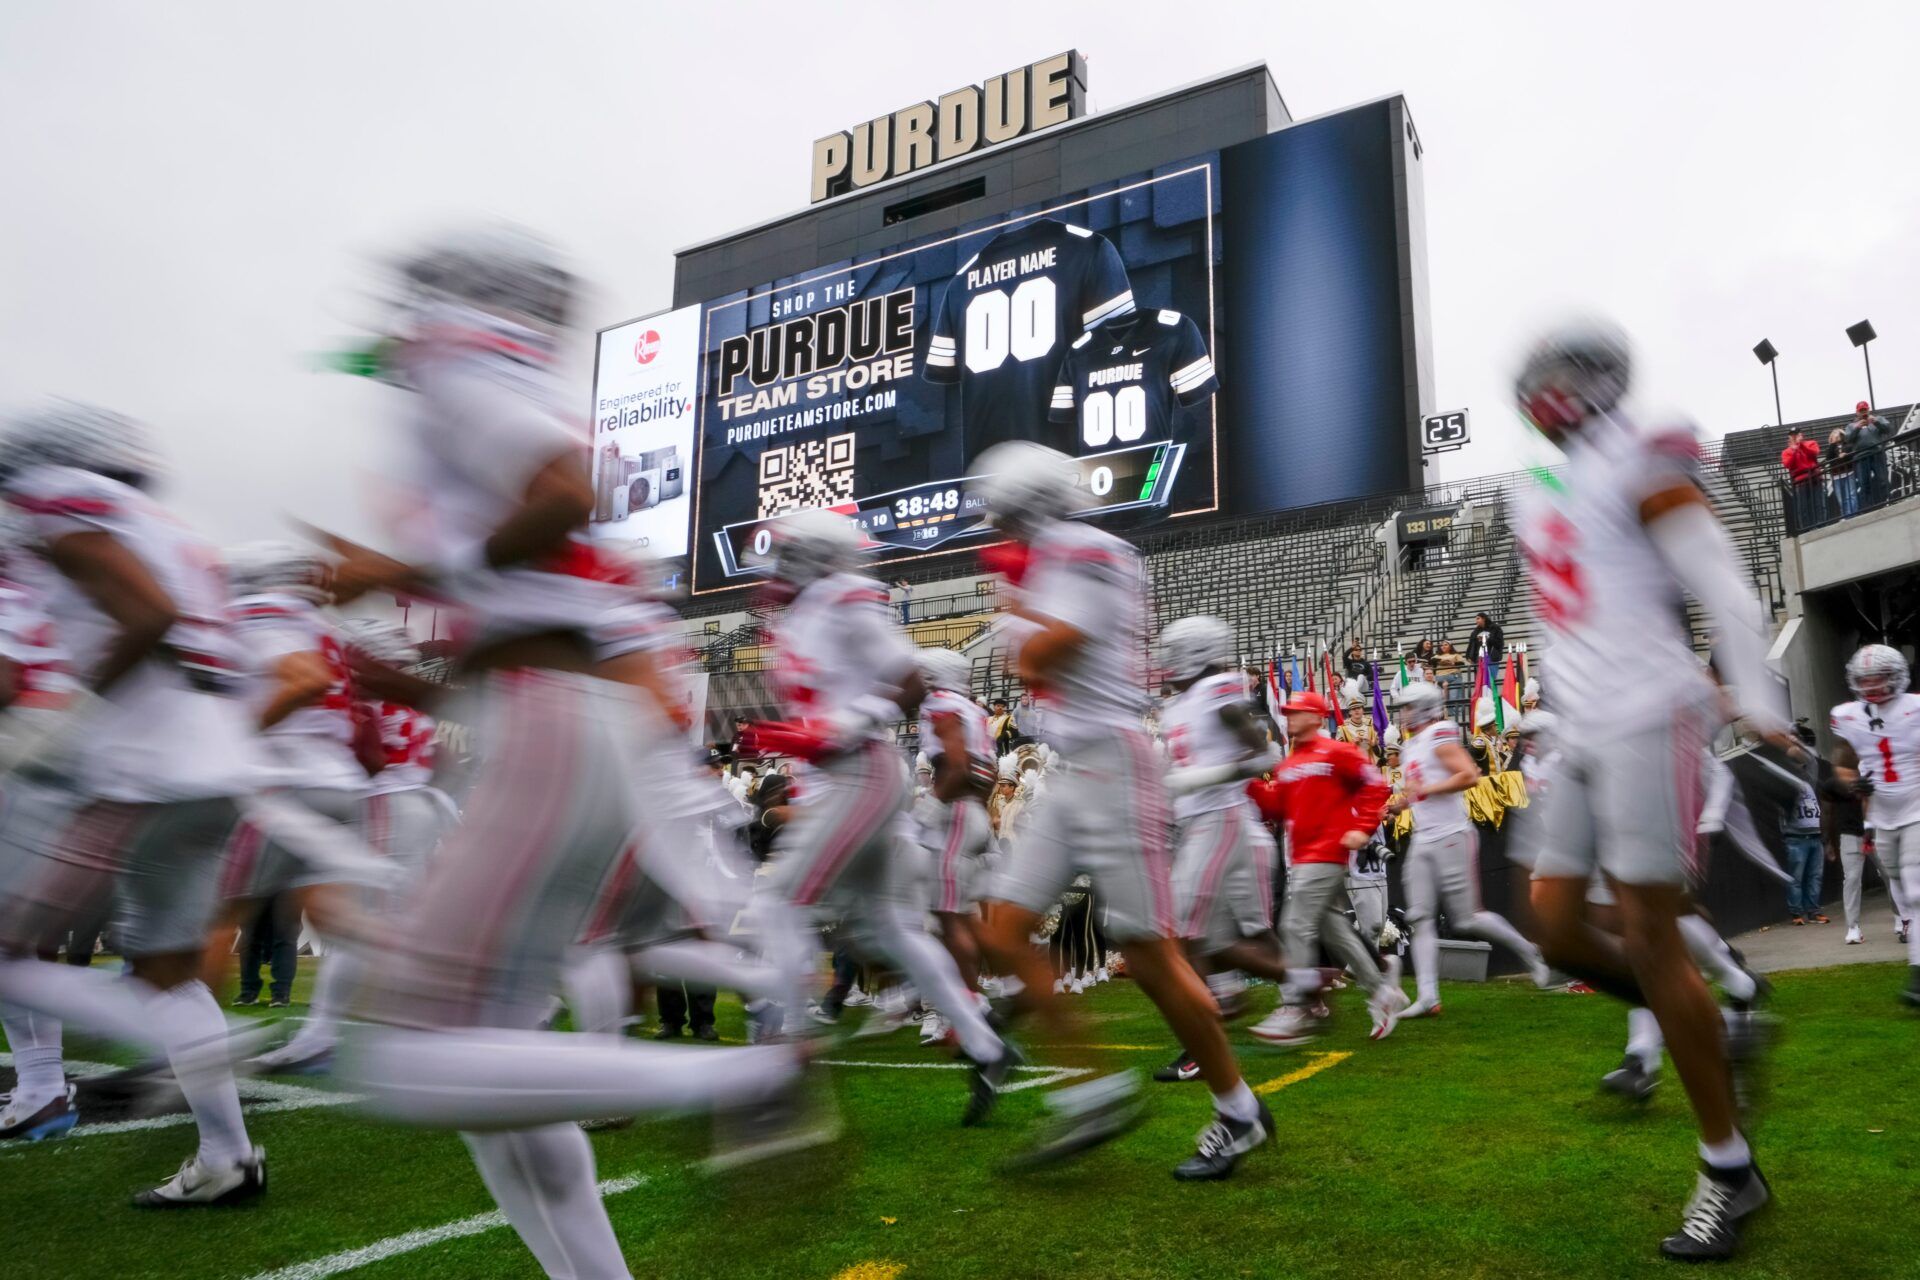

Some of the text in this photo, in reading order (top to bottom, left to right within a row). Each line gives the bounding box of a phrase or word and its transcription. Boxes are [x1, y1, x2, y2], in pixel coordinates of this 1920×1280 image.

[811, 49, 1078, 204] PURDUE
[967, 246, 1057, 291] PLAYER NAME
[772, 281, 856, 318] SHOP THE
[718, 286, 916, 399] PURDUE
[965, 275, 1056, 374] 00
[718, 353, 914, 422] TEAM STORE
[1088, 362, 1144, 388] PURDUE
[600, 381, 681, 411] Engineered for
[726, 389, 897, 445] PURDUETEAMSTORE.COM
[1083, 385, 1146, 447] 00
[1430, 415, 1462, 442] 25
[1091, 466, 1113, 495] 0
[873, 514, 888, 526] 10
[895, 489, 959, 519] 38:48
[754, 530, 772, 555] 0
[1406, 520, 1426, 534] 133
[1877, 736, 1899, 783] 1
